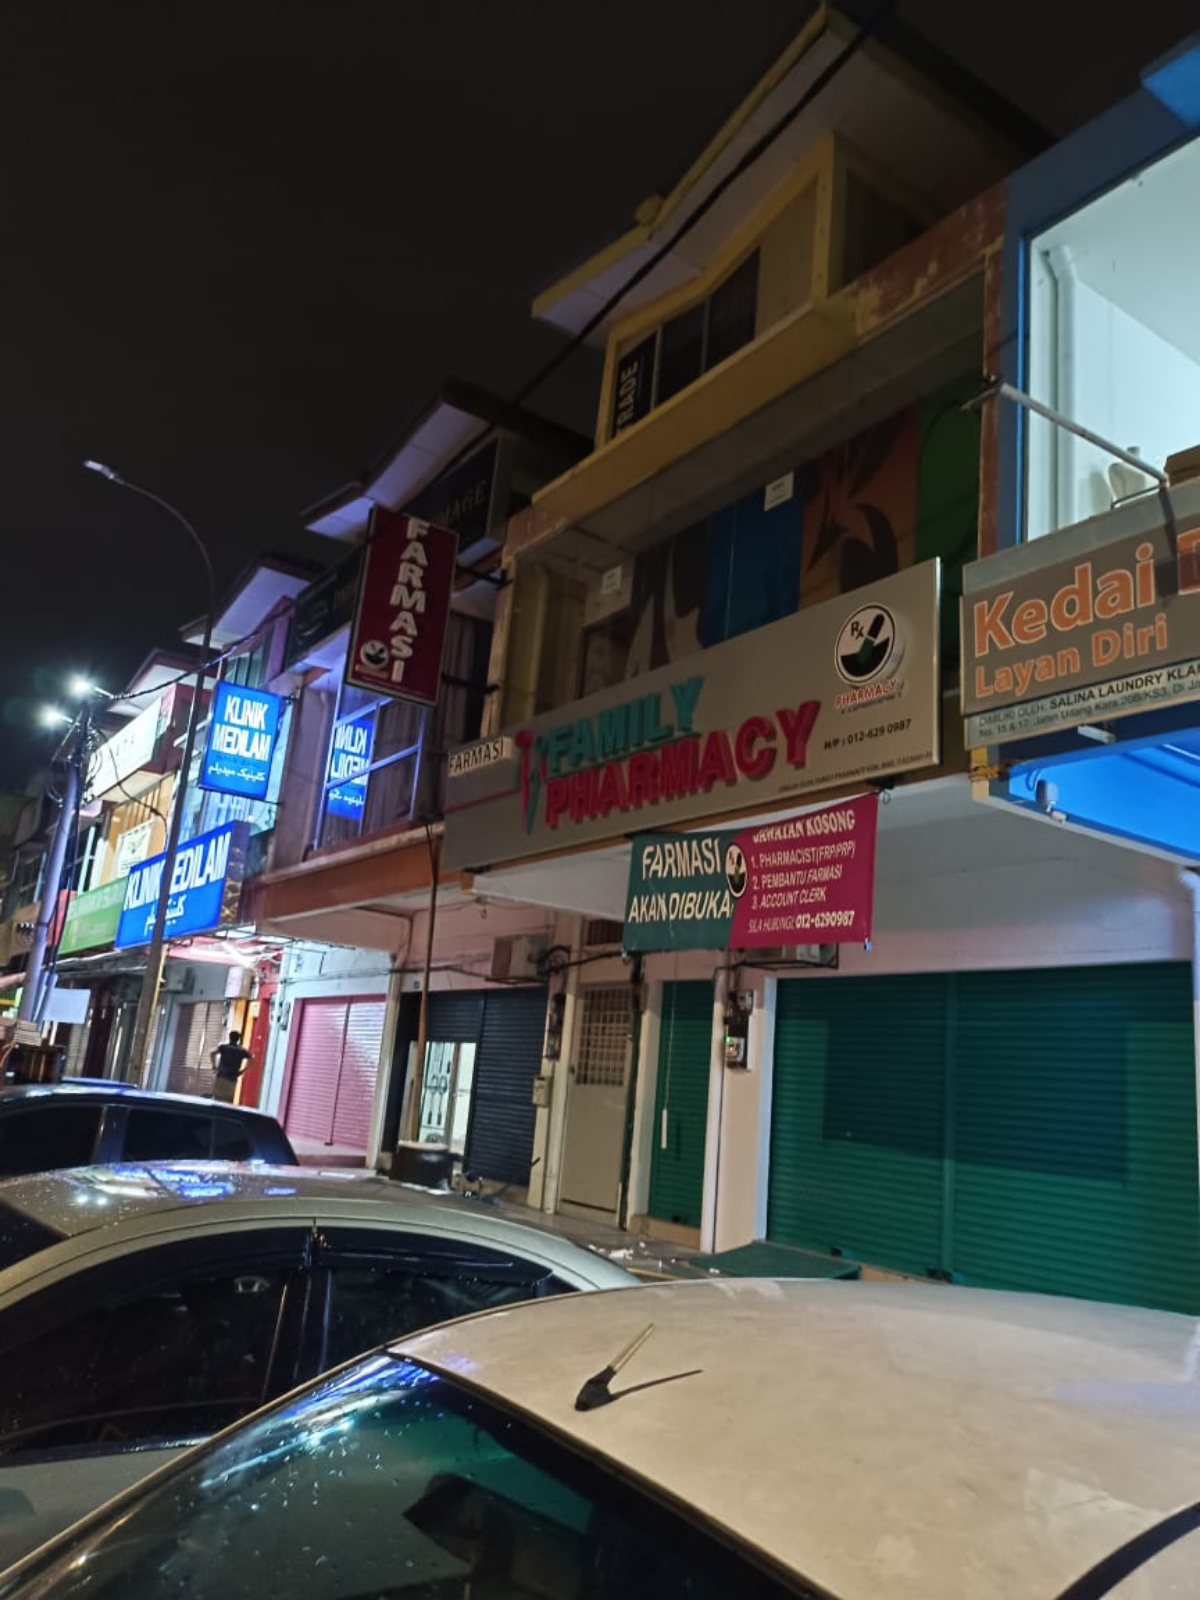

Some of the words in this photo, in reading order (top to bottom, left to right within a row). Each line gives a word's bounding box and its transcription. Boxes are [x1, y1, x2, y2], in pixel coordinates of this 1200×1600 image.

[616, 359, 638, 434] RADE
[389, 517, 430, 683] FARMASI
[974, 542, 1155, 658] Kedai
[975, 647, 1080, 698] Layan
[1091, 612, 1168, 668] Diri
[835, 677, 897, 709] PHARMACY
[1049, 692, 1096, 711] SALINA
[1098, 672, 1164, 699] LAUNDRY
[224, 695, 269, 731] KLINIK
[553, 676, 705, 774] FAMILY
[847, 725, 887, 745] 012-629
[886, 718, 913, 734] 0987
[212, 724, 272, 762] MEDILAM
[449, 738, 504, 776] FARMASI
[544, 699, 822, 828] PHARMACY
[805, 809, 856, 837] KOSONG
[123, 859, 167, 911] KLINIK
[169, 831, 231, 895] EDILAM
[642, 838, 722, 881] FARMASI
[761, 870, 806, 890] PEMBANTU
[806, 863, 843, 884] FARMASI
[628, 895, 668, 924] AKAN
[760, 890, 799, 908] ACCOUNT
[799, 887, 827, 904] CLERK
[796, 910, 855, 929] 012-6290987
